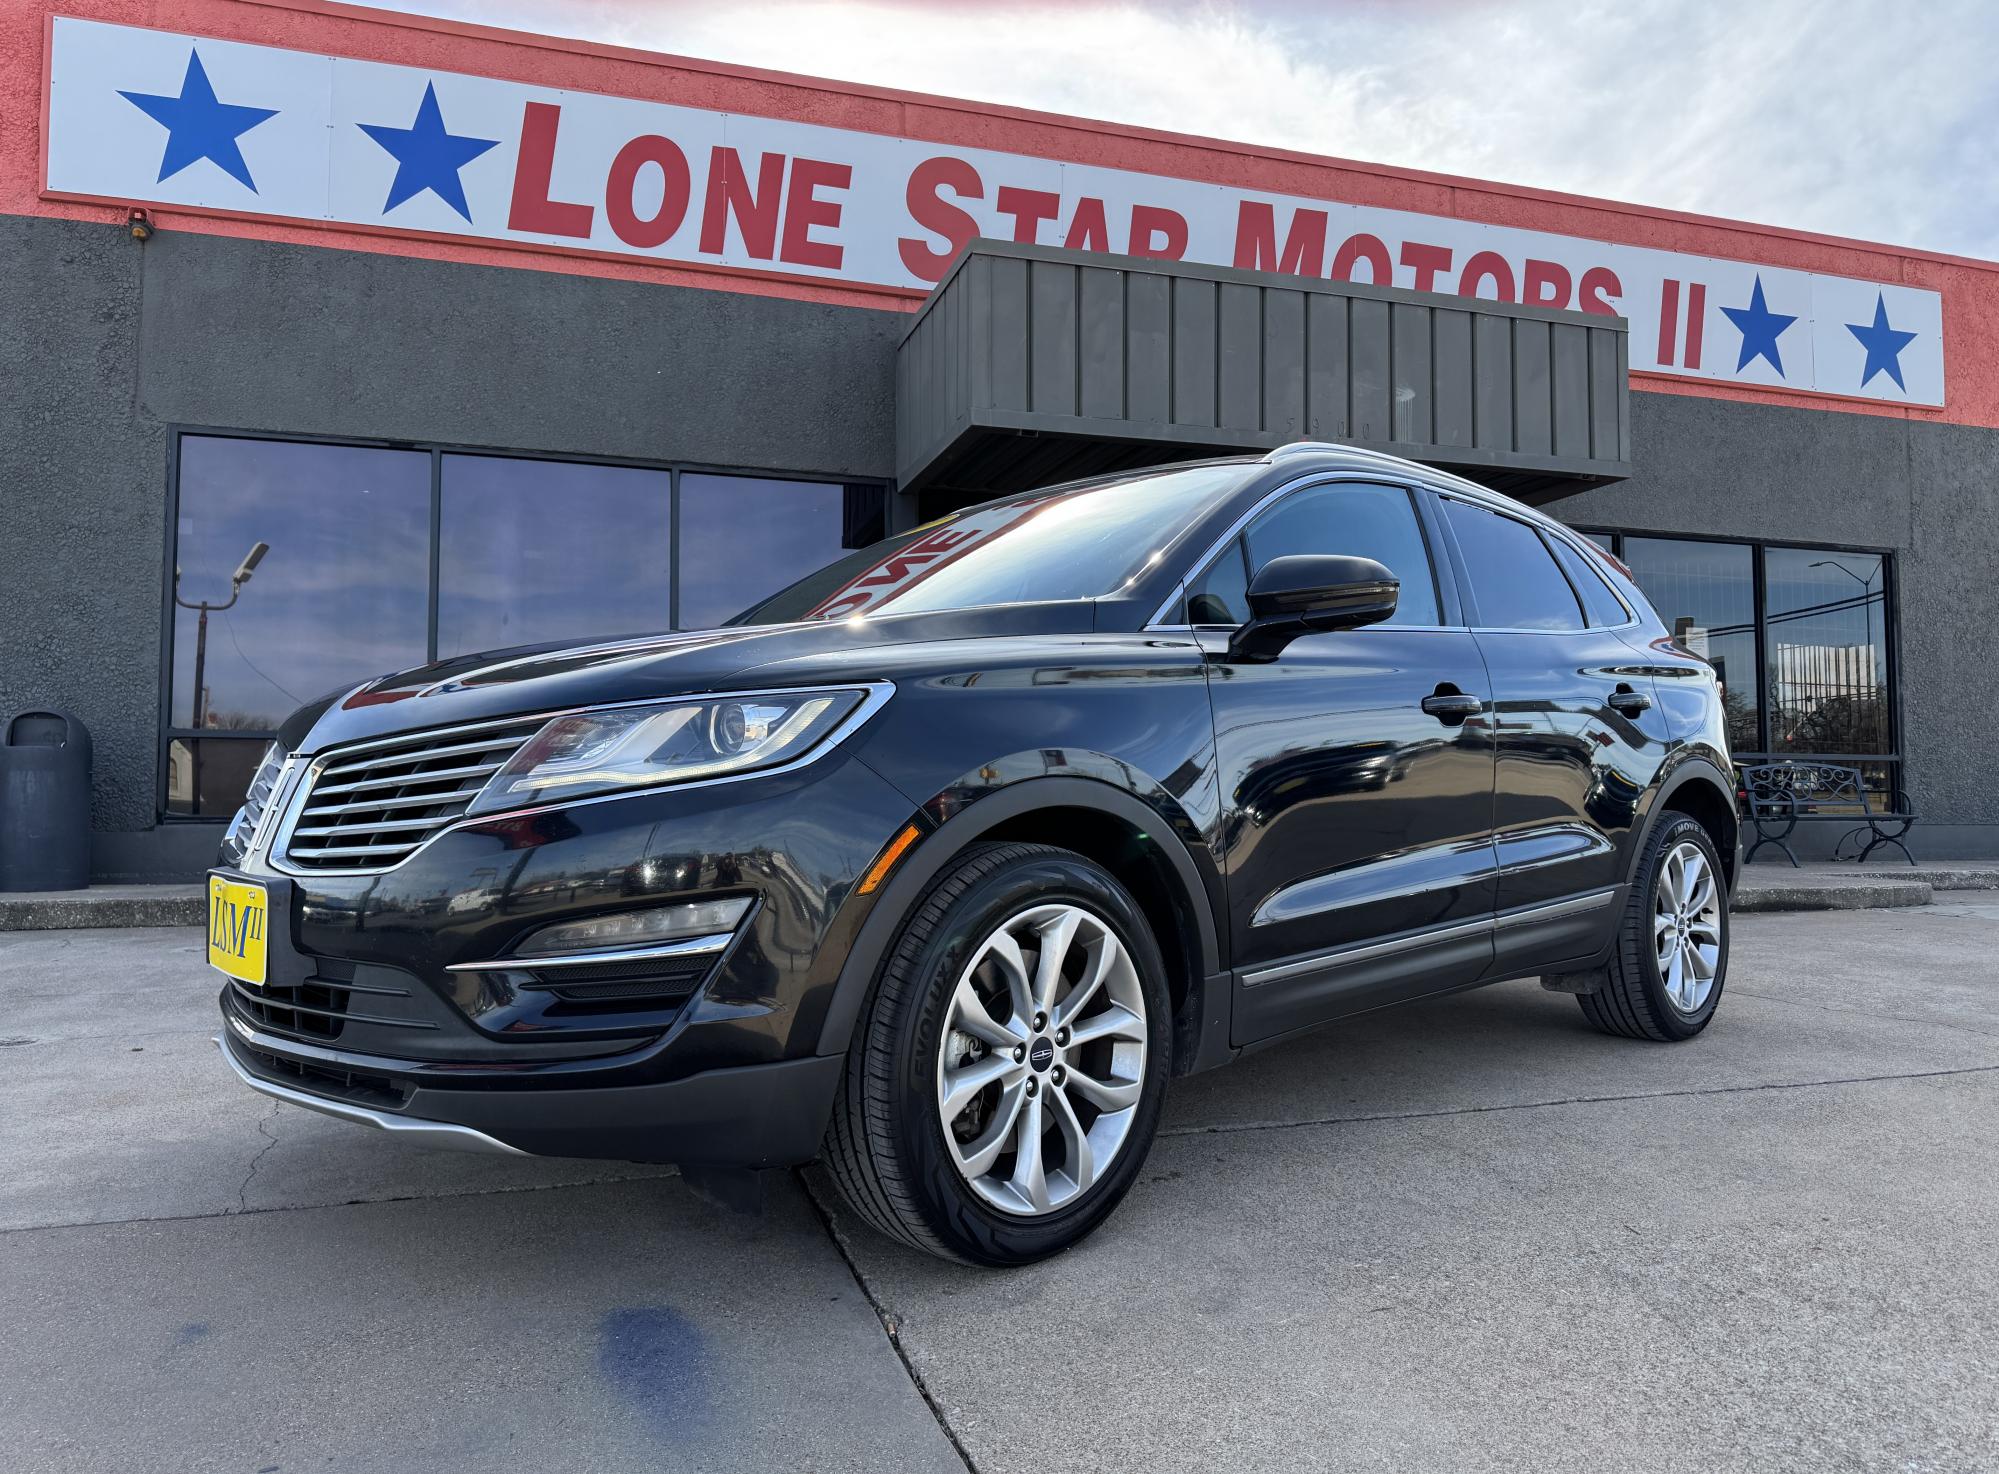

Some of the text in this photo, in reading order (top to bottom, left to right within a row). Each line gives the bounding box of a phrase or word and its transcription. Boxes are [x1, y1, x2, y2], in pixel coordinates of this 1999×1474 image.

[507, 101, 853, 271] LONE
[1656, 279, 1707, 370] II
[211, 896, 252, 958] LSM
